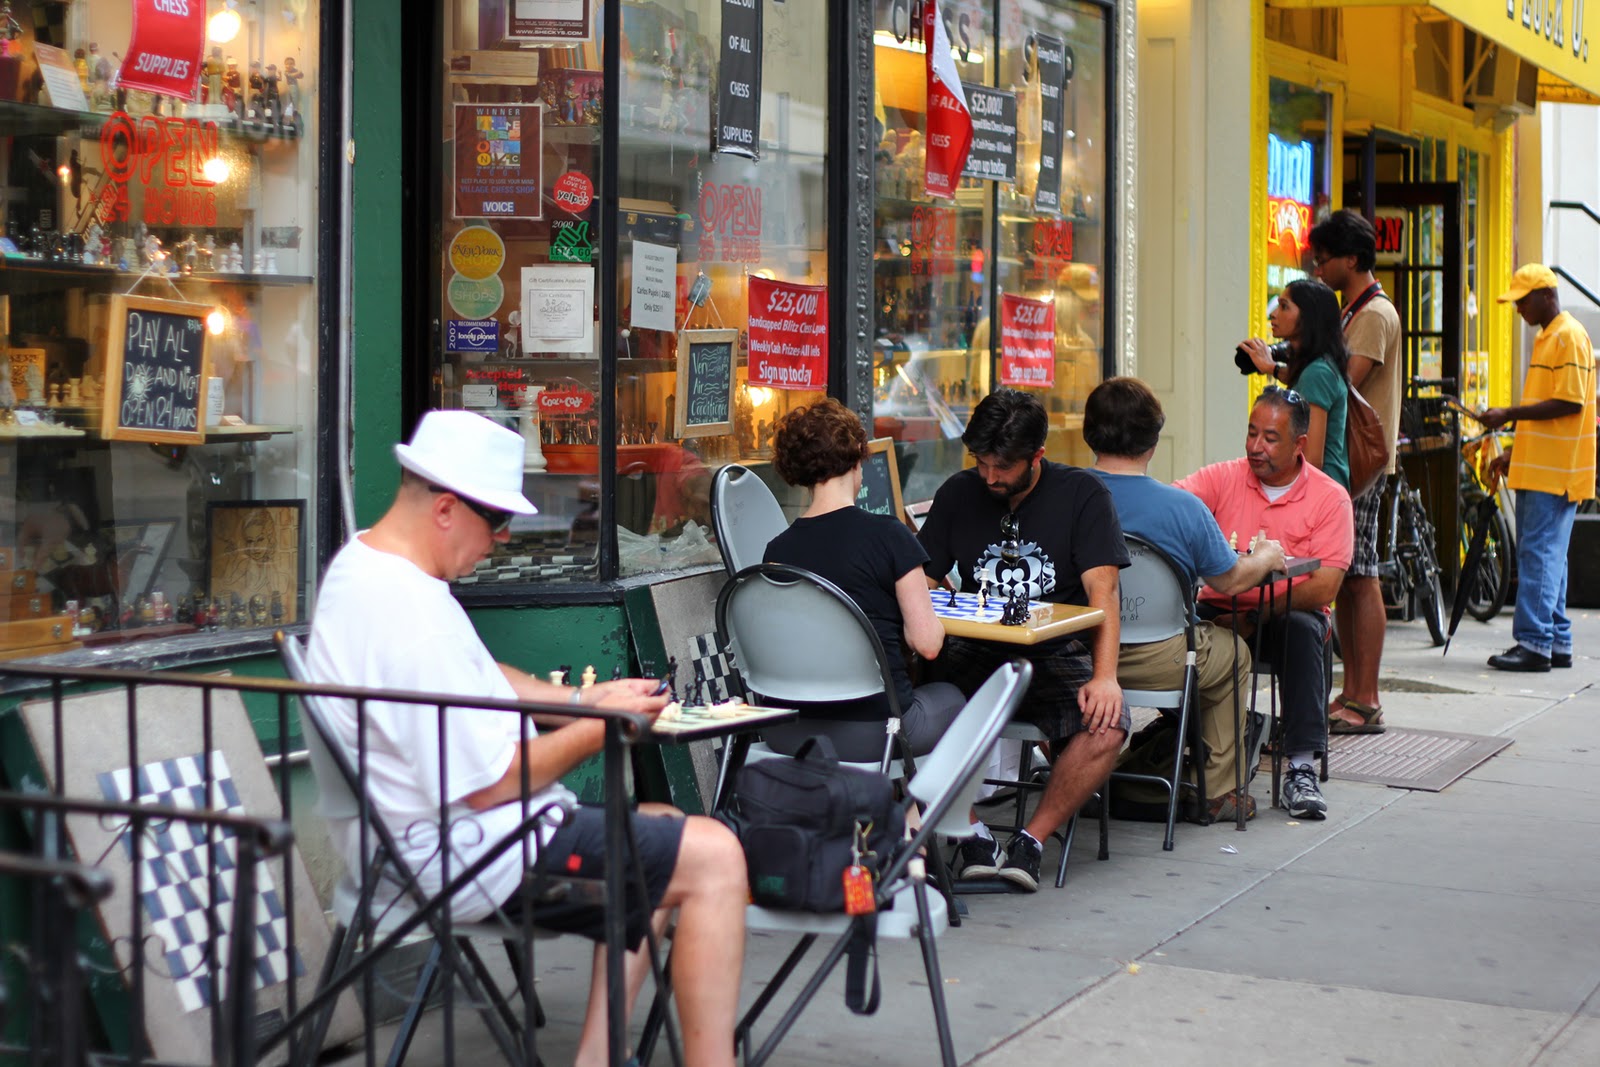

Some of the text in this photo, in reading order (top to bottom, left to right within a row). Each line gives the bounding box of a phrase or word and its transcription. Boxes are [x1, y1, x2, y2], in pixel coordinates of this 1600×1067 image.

[154, 0, 189, 17] CHESS
[728, 35, 751, 54] OF ALL
[134, 52, 190, 80] SUPPLIES
[730, 81, 750, 98] CHESS
[476, 108, 521, 116] WINNER
[940, 95, 963, 114] ALL
[971, 91, 1003, 116] $25,000!
[722, 125, 753, 143] SUPPLIES
[101, 111, 218, 188] OPEN
[967, 154, 1007, 178] Sign up today
[460, 185, 489, 193] VILLAGE
[557, 190, 579, 205] yelp
[144, 187, 218, 226] HOURS
[485, 201, 514, 212] VOICE
[699, 181, 762, 236] OPEN
[551, 220, 575, 228] 2009
[1375, 216, 1402, 252] EN
[782, 319, 798, 333] Blitz
[128, 312, 189, 362] PLAY ALL
[458, 332, 496, 341] lonely planet
[750, 339, 771, 356] Weekly
[154, 366, 177, 387] AND
[465, 368, 523, 382] Accepted
[759, 360, 812, 387] Sign up today
[498, 381, 527, 392] Here
[121, 391, 198, 430] OPEN 24 HOURS
